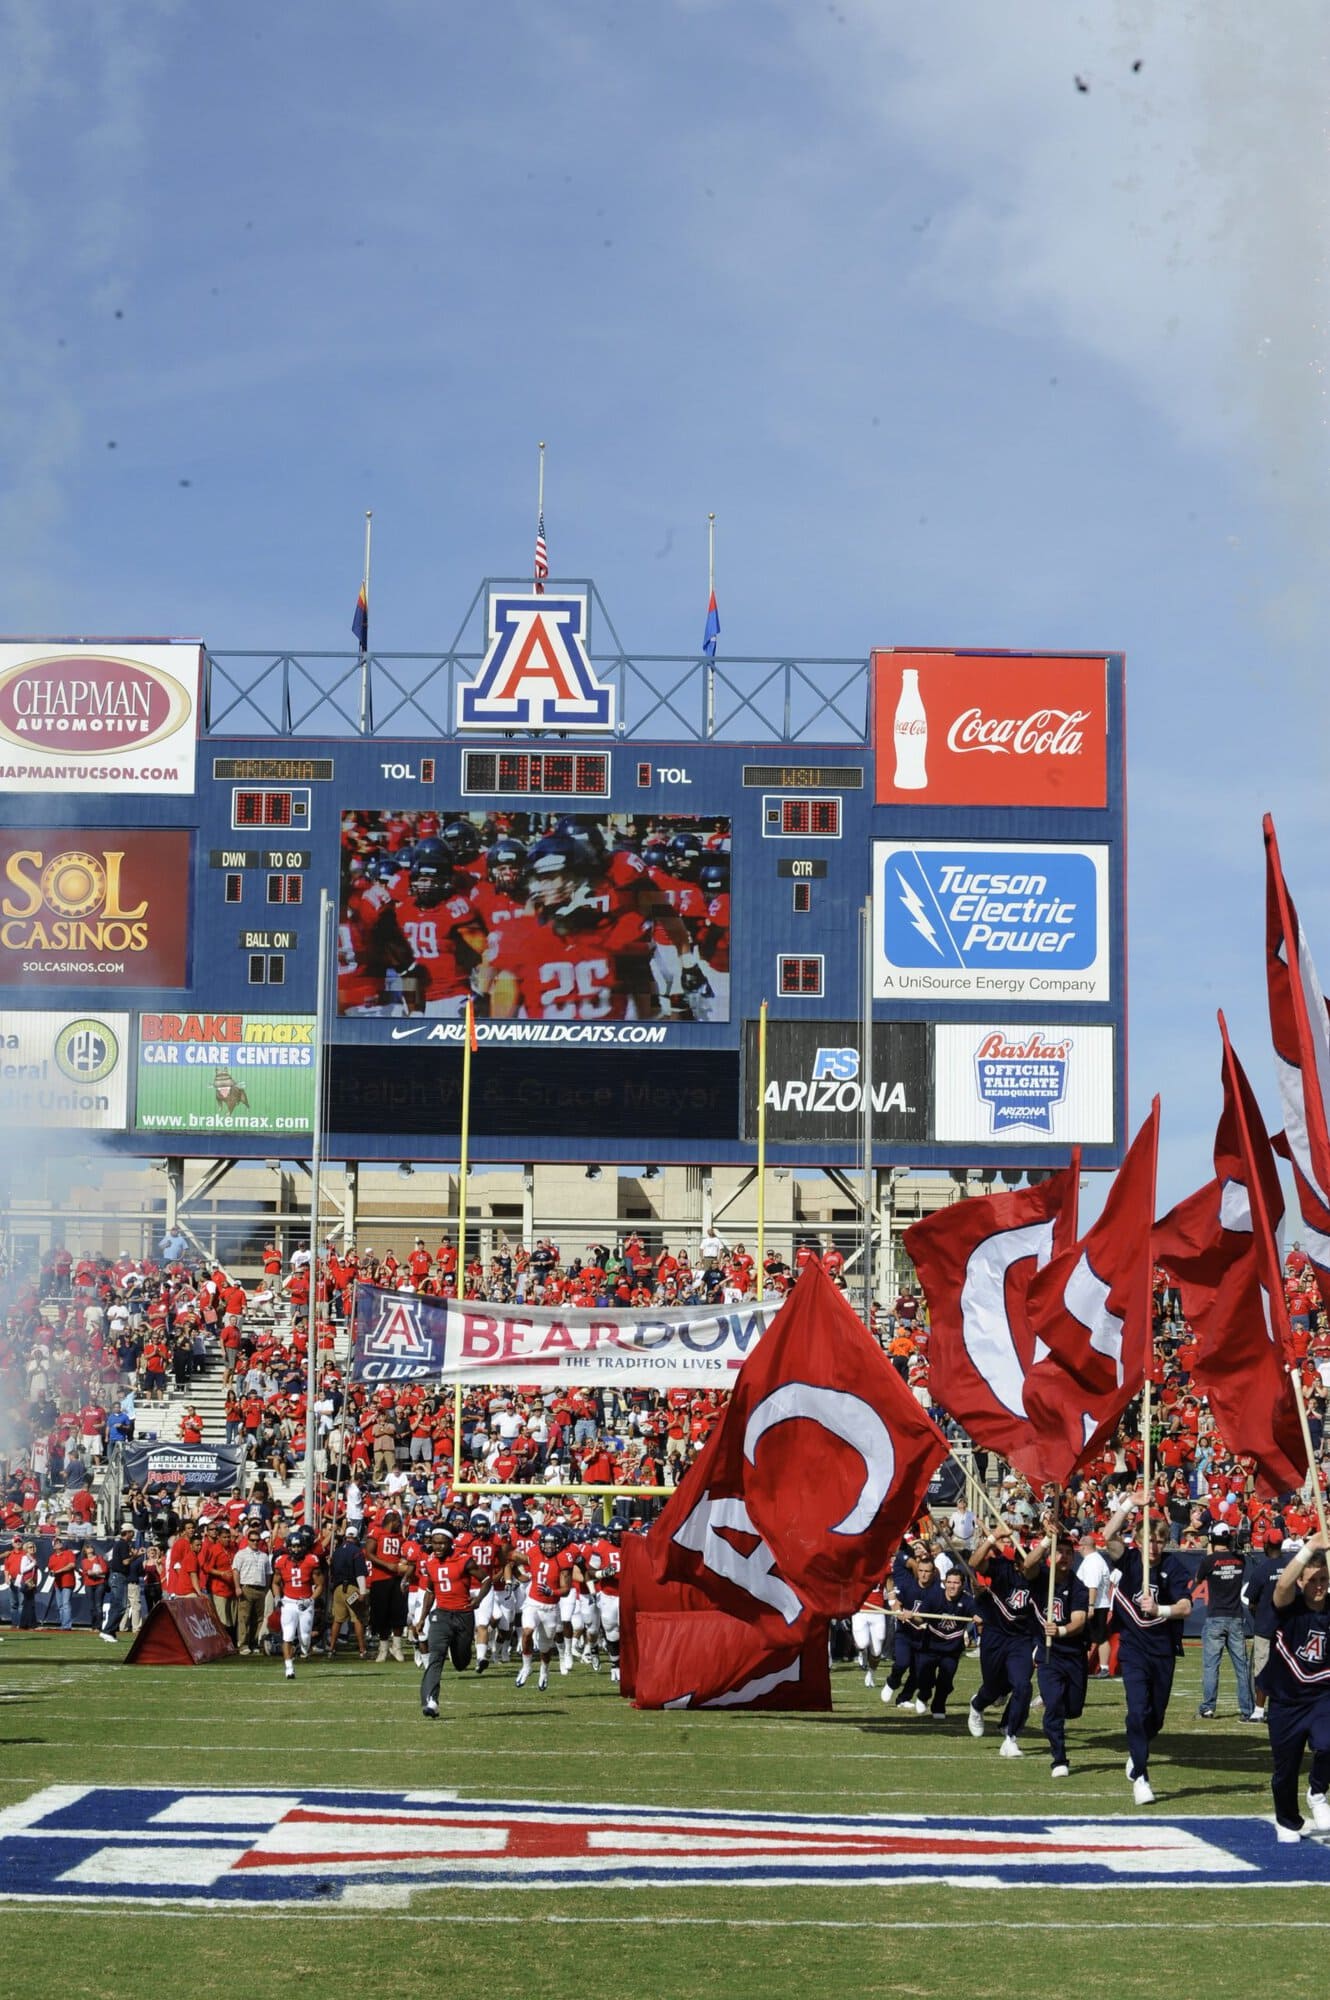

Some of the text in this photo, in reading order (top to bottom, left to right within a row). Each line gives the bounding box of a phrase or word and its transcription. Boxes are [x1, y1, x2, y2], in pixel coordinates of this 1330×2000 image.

[457, 593, 615, 730] A
[12, 680, 152, 717] CHAPMAN
[16, 719, 149, 732] AUTOMOTIVE
[948, 708, 1091, 754] Coca-Cola
[234, 760, 314, 779] ARIZONA
[381, 764, 416, 779] TOL
[657, 768, 692, 784] TOL
[222, 852, 246, 867] DWN
[269, 852, 302, 868] TO GO
[792, 861, 813, 876] QTR
[938, 866, 1047, 895] Tucson
[950, 898, 1076, 924] Electric
[1, 922, 148, 951] CASINOS
[246, 933, 289, 947] BALL ON
[962, 924, 1075, 952] Power
[23, 962, 124, 973] SOLCASINOS.COM
[783, 960, 819, 991] 25
[884, 976, 1096, 993] A UniSource Energy Company
[141, 1015, 315, 1044] BRAKE max
[144, 1046, 310, 1065] CAR CARE CENTERS
[978, 1034, 1069, 1058] Bashas'
[813, 1049, 859, 1080] FS
[984, 1065, 1059, 1076] OFFICIAL
[984, 1078, 1059, 1088] TAILGATE
[39, 1090, 109, 1111] Union
[757, 1080, 907, 1112] ARIZONA
[997, 1106, 1046, 1116] ARIZONA
[143, 1114, 309, 1129] www.brakemax.com
[362, 1361, 430, 1380] CLUB
[565, 1357, 721, 1370] THE TRADITION LIVES
[148, 1472, 218, 1485] Family ZONE
[383, 1538, 399, 1555] 69
[472, 1546, 492, 1566] 92
[291, 1568, 302, 1587] 2
[438, 1567, 451, 1592] 5
[537, 1562, 549, 1585] 2
